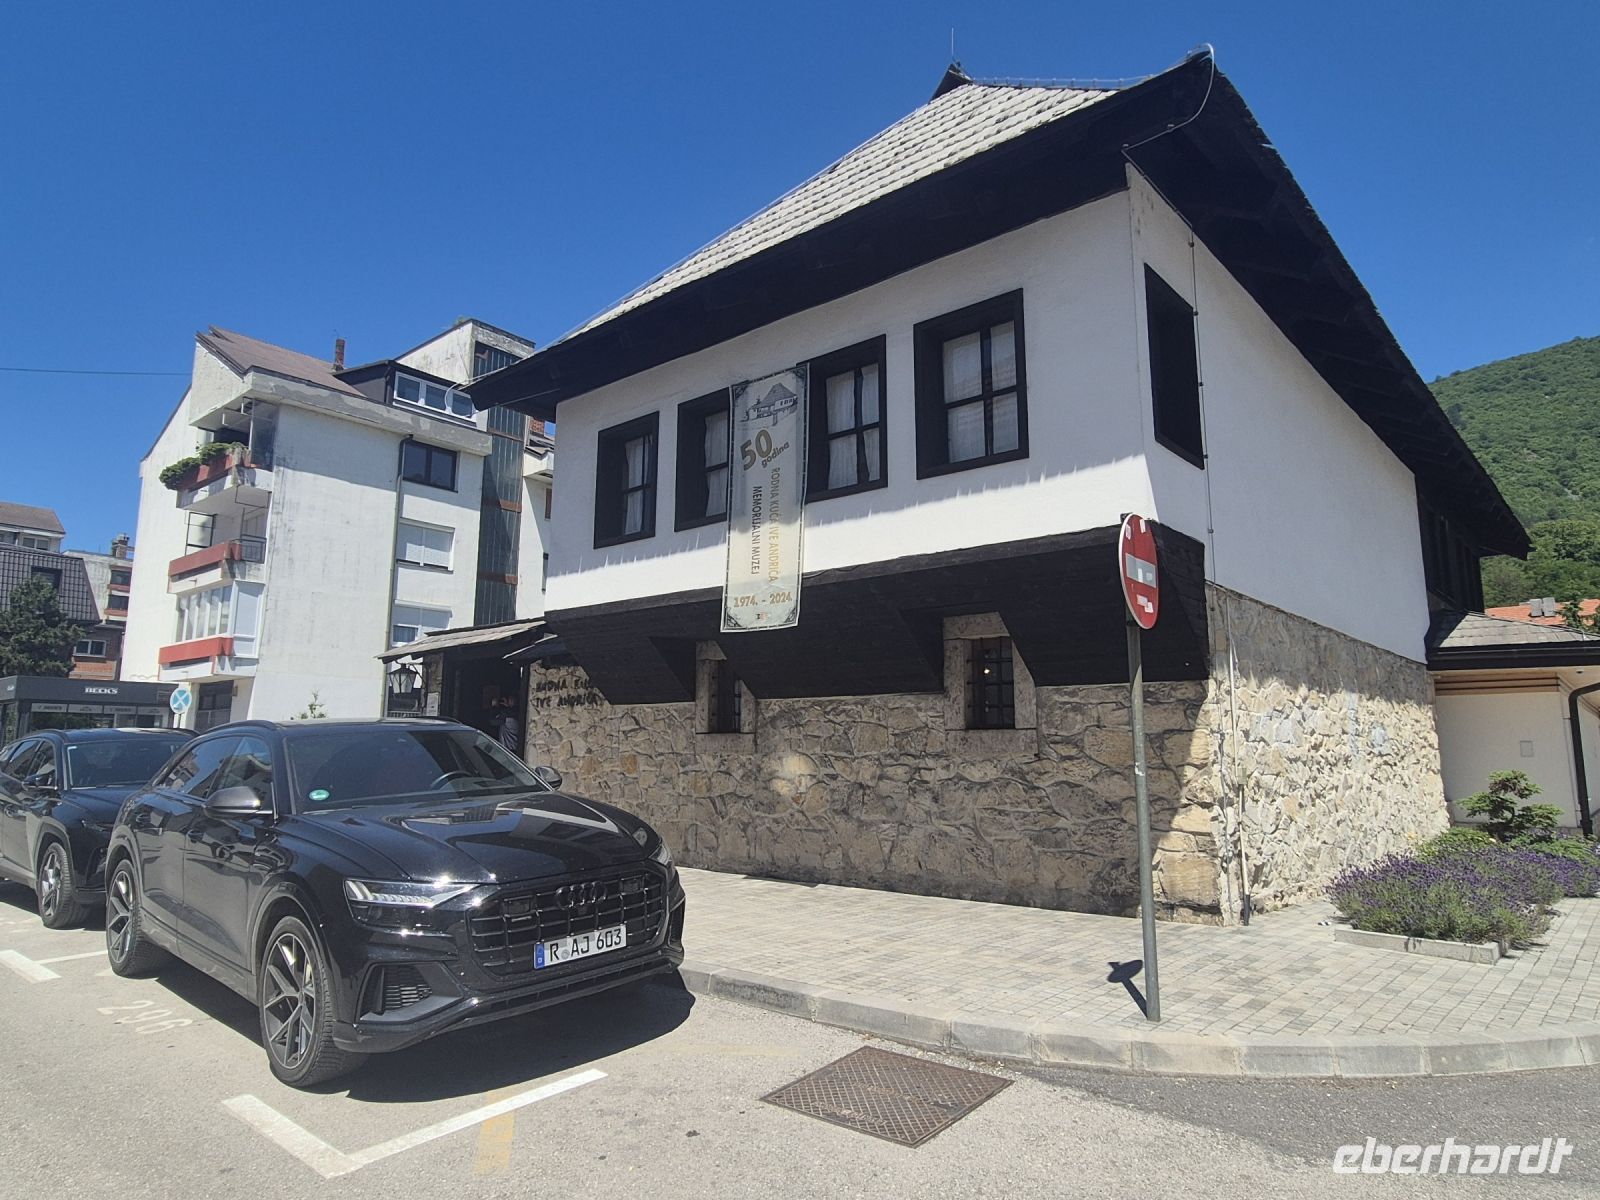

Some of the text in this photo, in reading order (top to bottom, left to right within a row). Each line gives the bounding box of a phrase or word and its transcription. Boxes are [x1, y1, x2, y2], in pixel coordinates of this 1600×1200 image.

[740, 429, 772, 471] 50
[761, 441, 790, 468] godina
[769, 467, 781, 499] RODNA
[750, 485, 762, 575] MEMORIJALNI MUZEJ
[768, 527, 780, 542] IVE
[549, 928, 622, 962] R AJ 603
